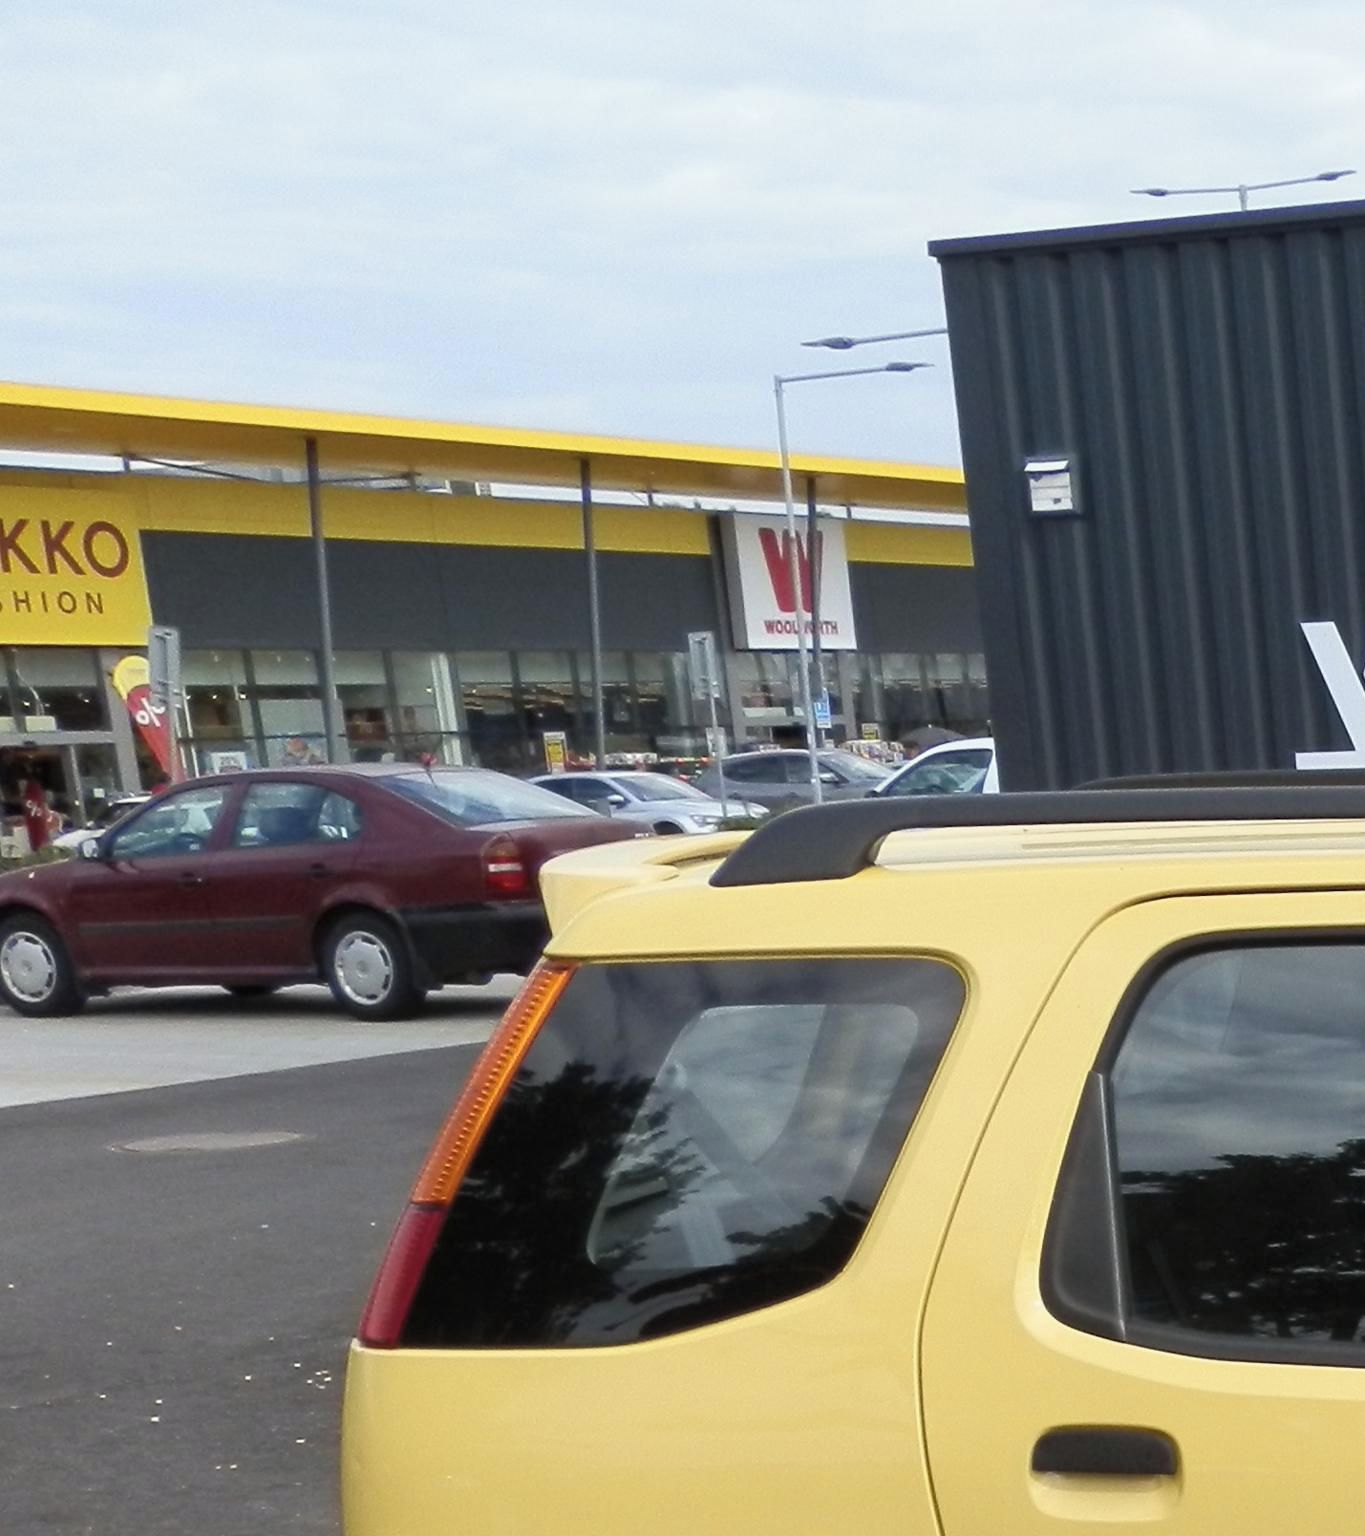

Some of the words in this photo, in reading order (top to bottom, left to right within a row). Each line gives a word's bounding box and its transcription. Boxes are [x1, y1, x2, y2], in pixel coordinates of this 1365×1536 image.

[0, 518, 129, 578] KKO
[758, 527, 824, 613] W
[0, 590, 104, 615] HION
